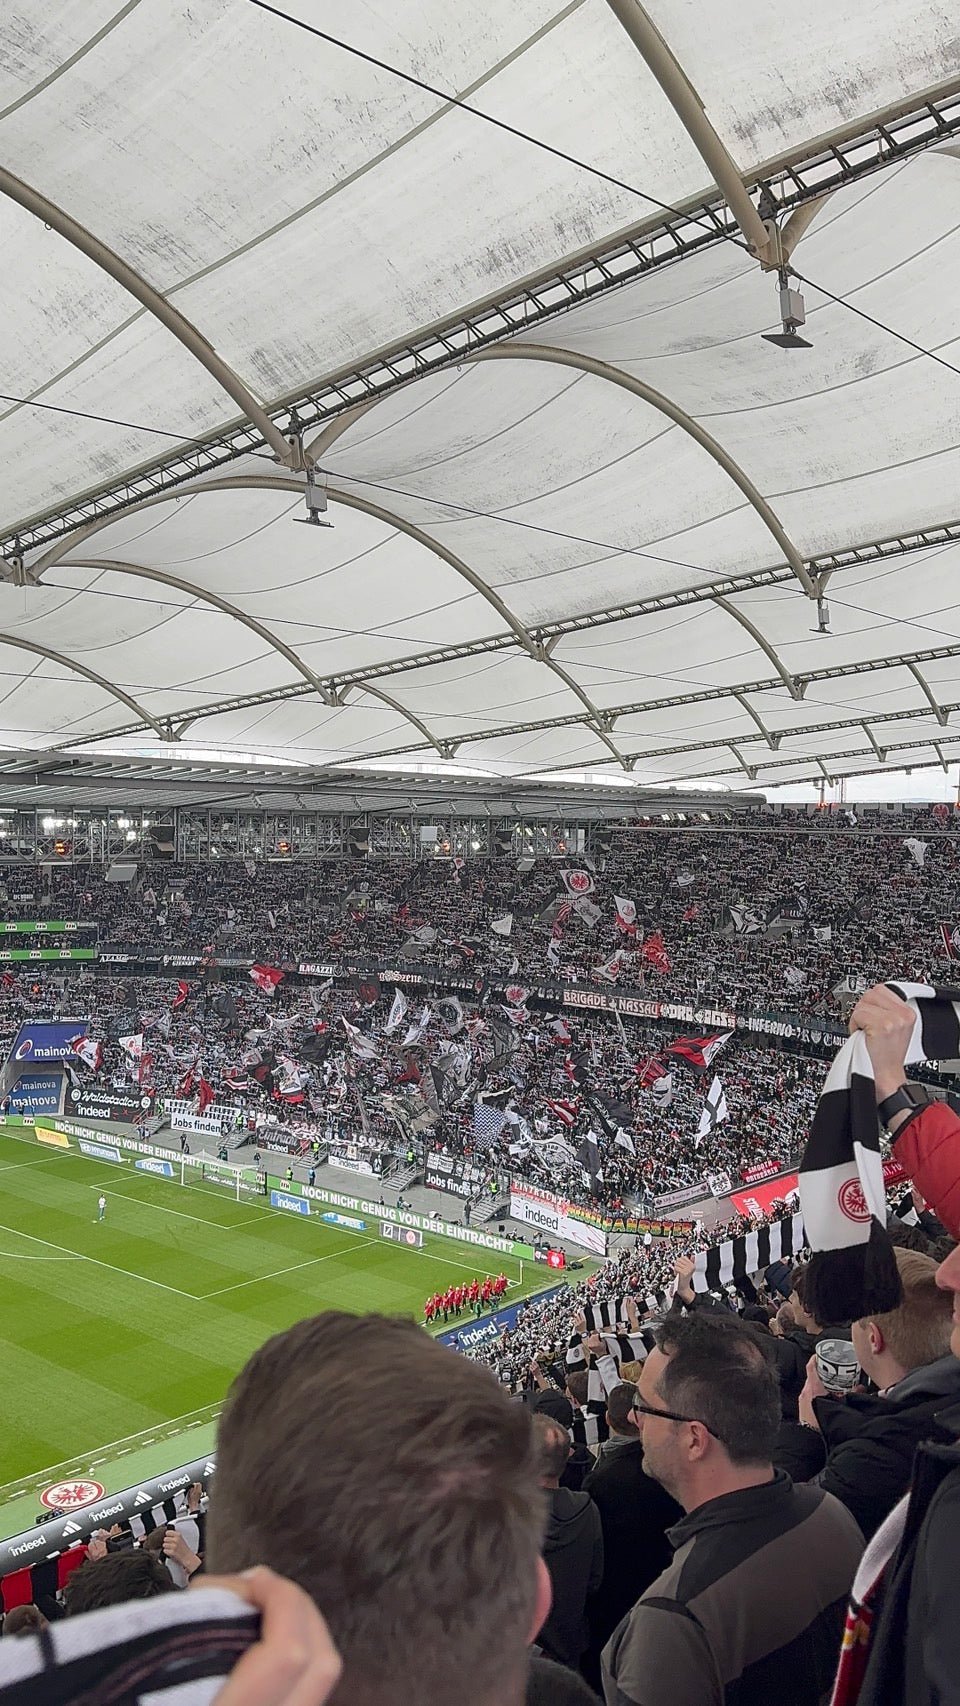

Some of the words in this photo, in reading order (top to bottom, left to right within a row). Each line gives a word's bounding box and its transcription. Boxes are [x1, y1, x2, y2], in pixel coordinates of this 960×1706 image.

[299, 963, 333, 975] RAGAZZI
[563, 991, 607, 1007] BRIGADE
[618, 999, 658, 1016] NASSAU
[34, 1046, 77, 1057] mainova
[22, 1080, 56, 1091] mainova
[12, 1095, 57, 1108] mainova
[81, 1090, 141, 1109] Waldstadion
[76, 1102, 111, 1118] indeed
[173, 1116, 193, 1130] Jobs
[194, 1120, 221, 1134] finden
[55, 1121, 75, 1136] NOCH
[75, 1126, 96, 1141] NICHT
[96, 1132, 122, 1147] GENUG
[122, 1138, 138, 1151] VON
[138, 1142, 154, 1155] DER
[266, 1141, 289, 1154] indeed
[141, 1160, 165, 1175] indeed
[426, 1171, 447, 1189] Jobs
[276, 1196, 302, 1213] indeed
[302, 1185, 329, 1203] NOCH
[330, 1192, 359, 1211] NICHT
[361, 1200, 397, 1220] GENUG
[398, 1210, 421, 1226] VON
[422, 1217, 445, 1234] DER
[446, 1226, 515, 1254] EINTRACHT?
[522, 1202, 559, 1231] indeed
[457, 1321, 498, 1347] indeed
[157, 1473, 191, 1494] indeed
[88, 1502, 125, 1523] indeed
[8, 1534, 47, 1558] indeed
